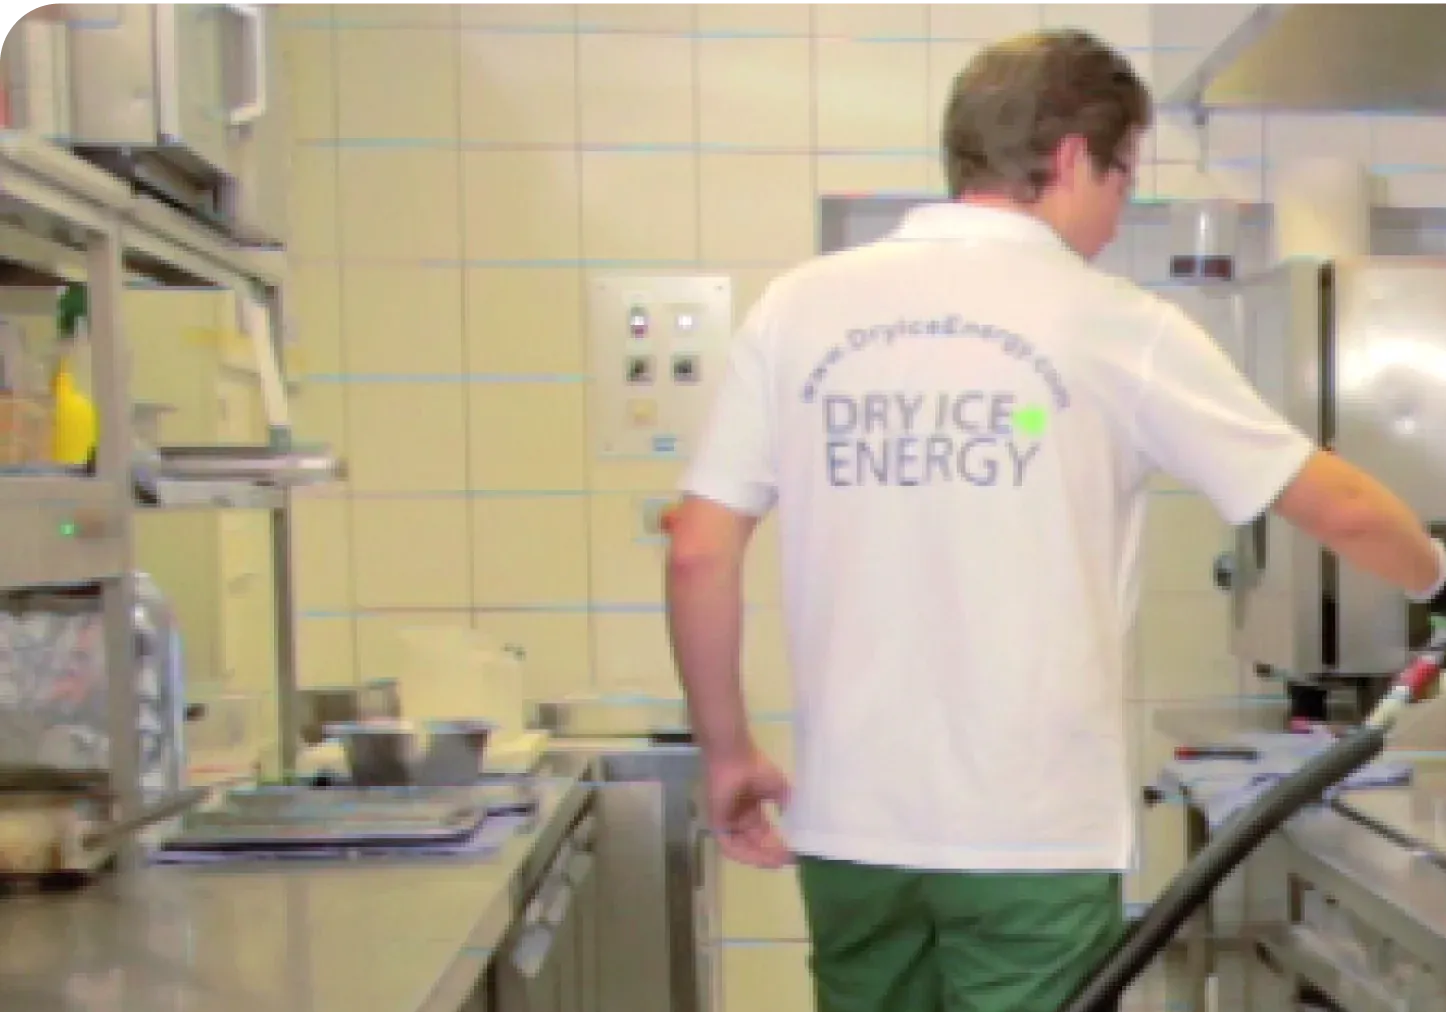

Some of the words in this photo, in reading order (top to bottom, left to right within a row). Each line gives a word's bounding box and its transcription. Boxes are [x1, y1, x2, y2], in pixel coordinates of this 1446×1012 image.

[822, 393, 923, 434] DRY
[935, 393, 1016, 434] ICE
[825, 436, 1041, 487] ENERGY
